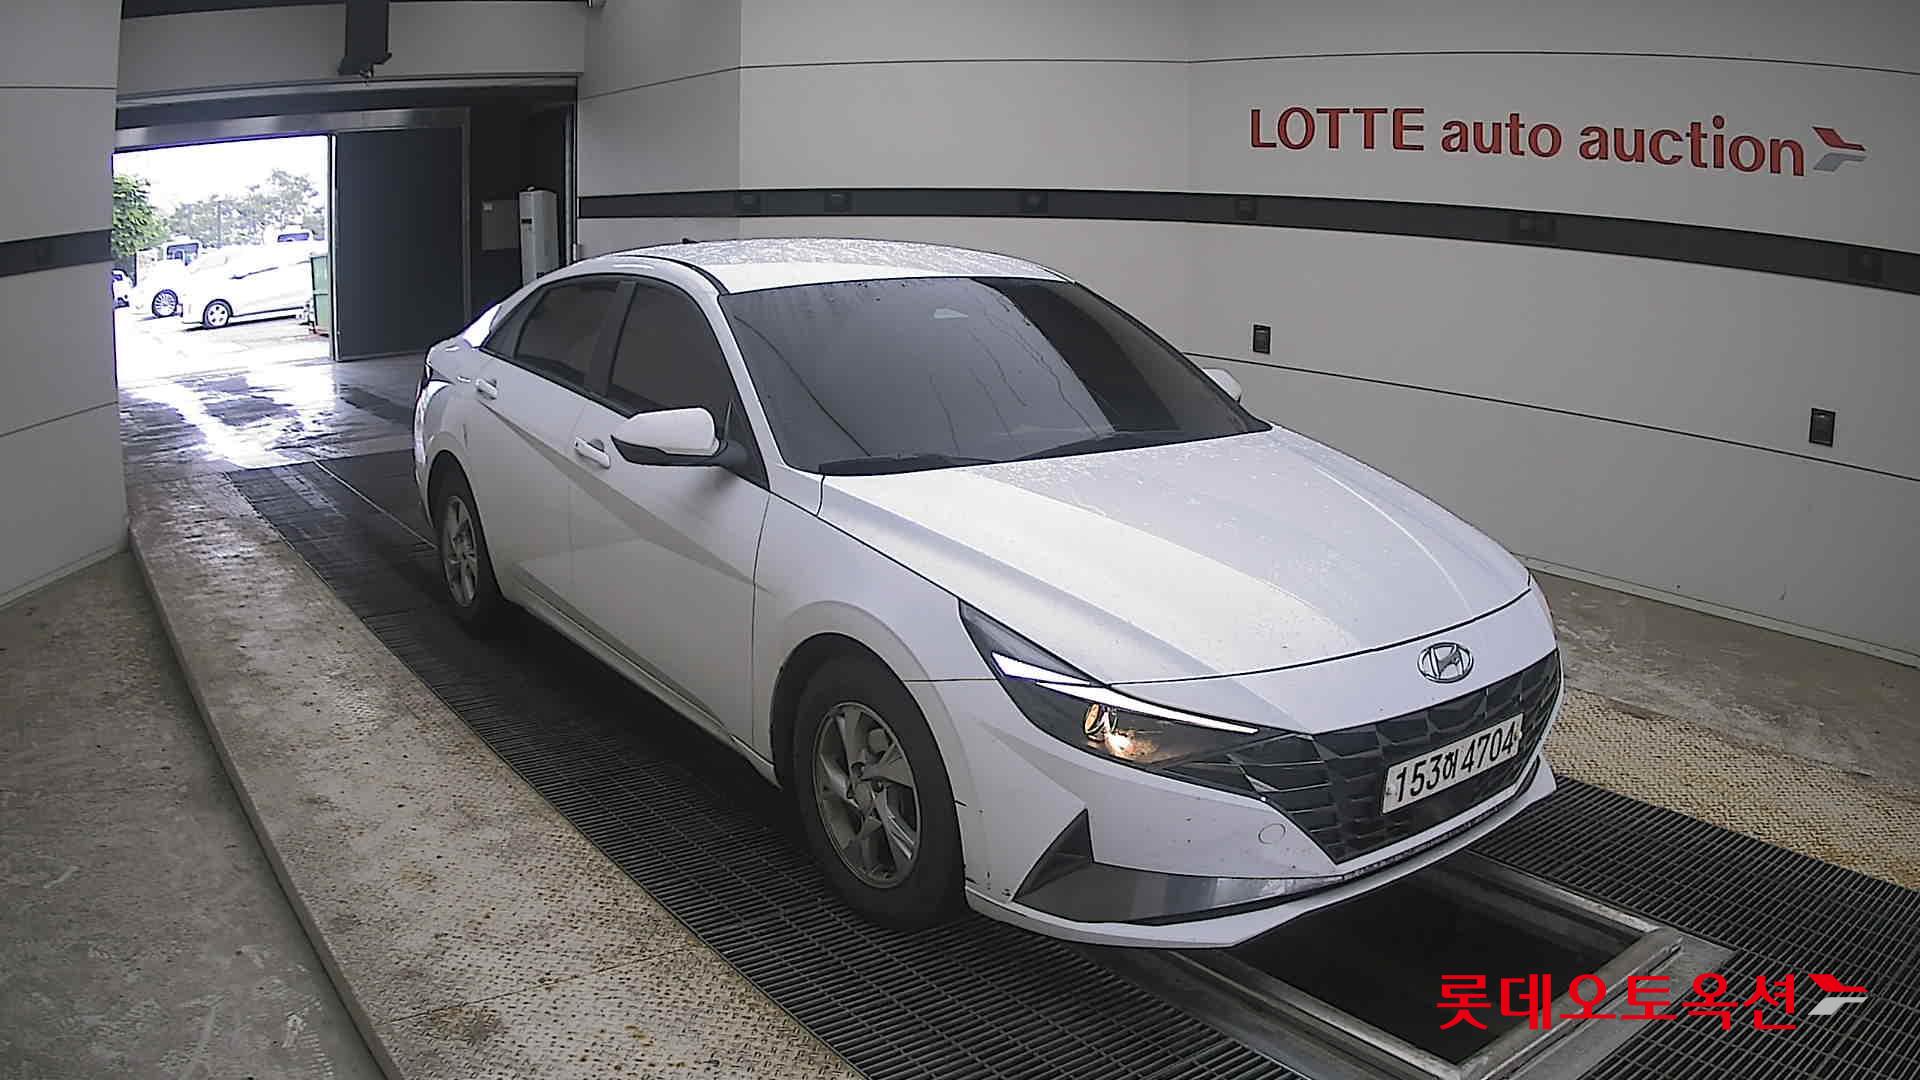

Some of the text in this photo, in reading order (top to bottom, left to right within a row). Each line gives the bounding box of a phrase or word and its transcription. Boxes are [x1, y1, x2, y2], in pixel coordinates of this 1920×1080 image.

[1250, 107, 1806, 176] LOTTE auto auction
